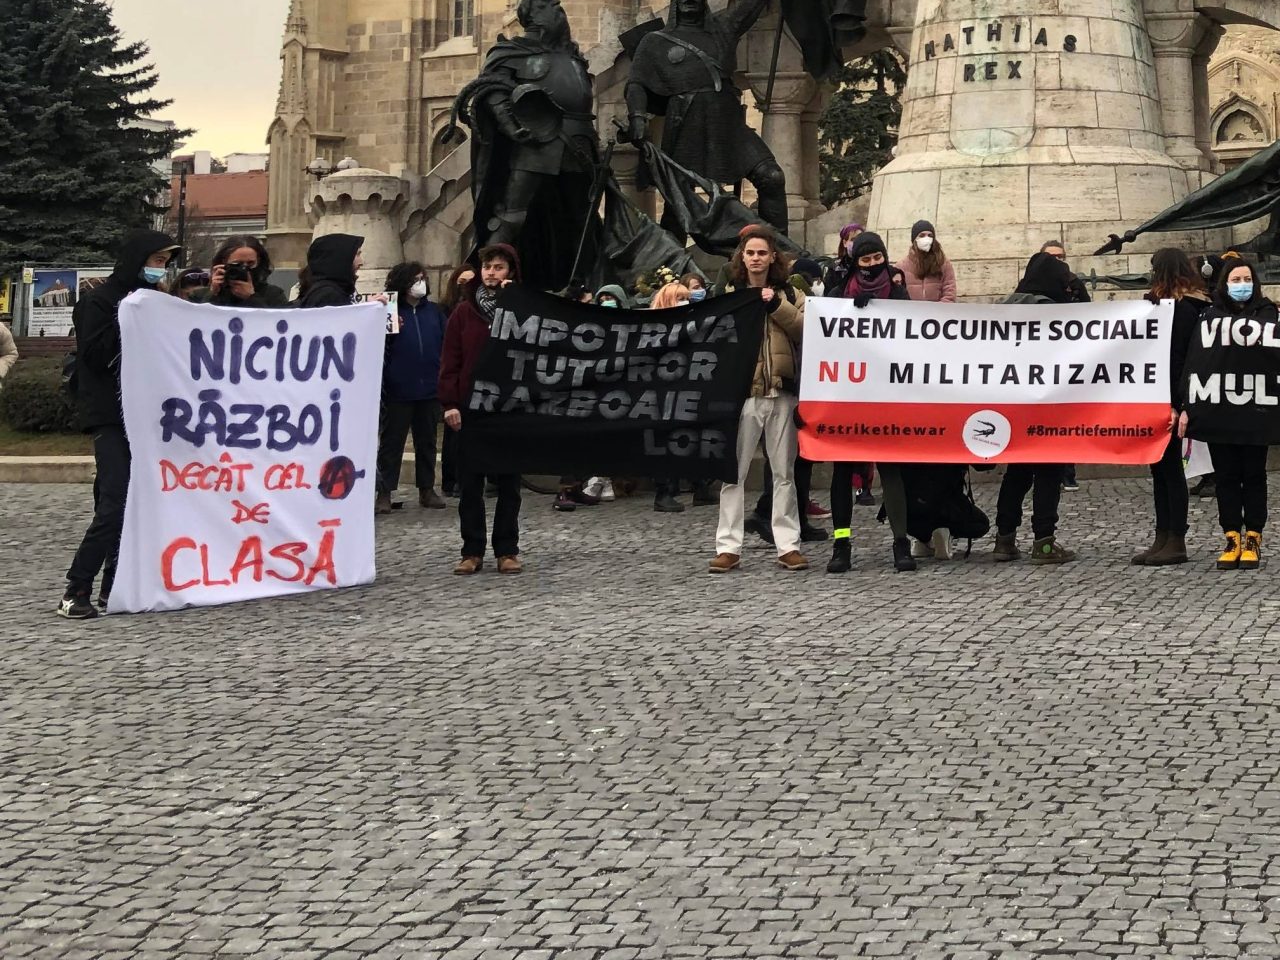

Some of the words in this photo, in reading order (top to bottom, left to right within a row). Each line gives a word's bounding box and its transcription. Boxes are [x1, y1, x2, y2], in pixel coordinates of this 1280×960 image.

[924, 22, 1077, 61] MATHIAS
[963, 60, 1023, 82] REX
[490, 307, 738, 352] IMPOTRIVA
[819, 316, 896, 339] VREM
[905, 318, 1041, 347] LOCUINȚE
[1048, 318, 1159, 340] SOCIALE
[189, 316, 356, 385] NICIUN
[507, 349, 718, 386] TUTUROR
[818, 360, 868, 384] NU
[889, 362, 1157, 385] MILITARIZARE
[643, 429, 727, 459] LOR
[815, 423, 946, 436] #strikethewar
[1026, 424, 1154, 438] #8martiefeminist
[160, 452, 254, 492] DECÂT
[264, 463, 312, 491] CEL
[231, 499, 270, 525] DE
